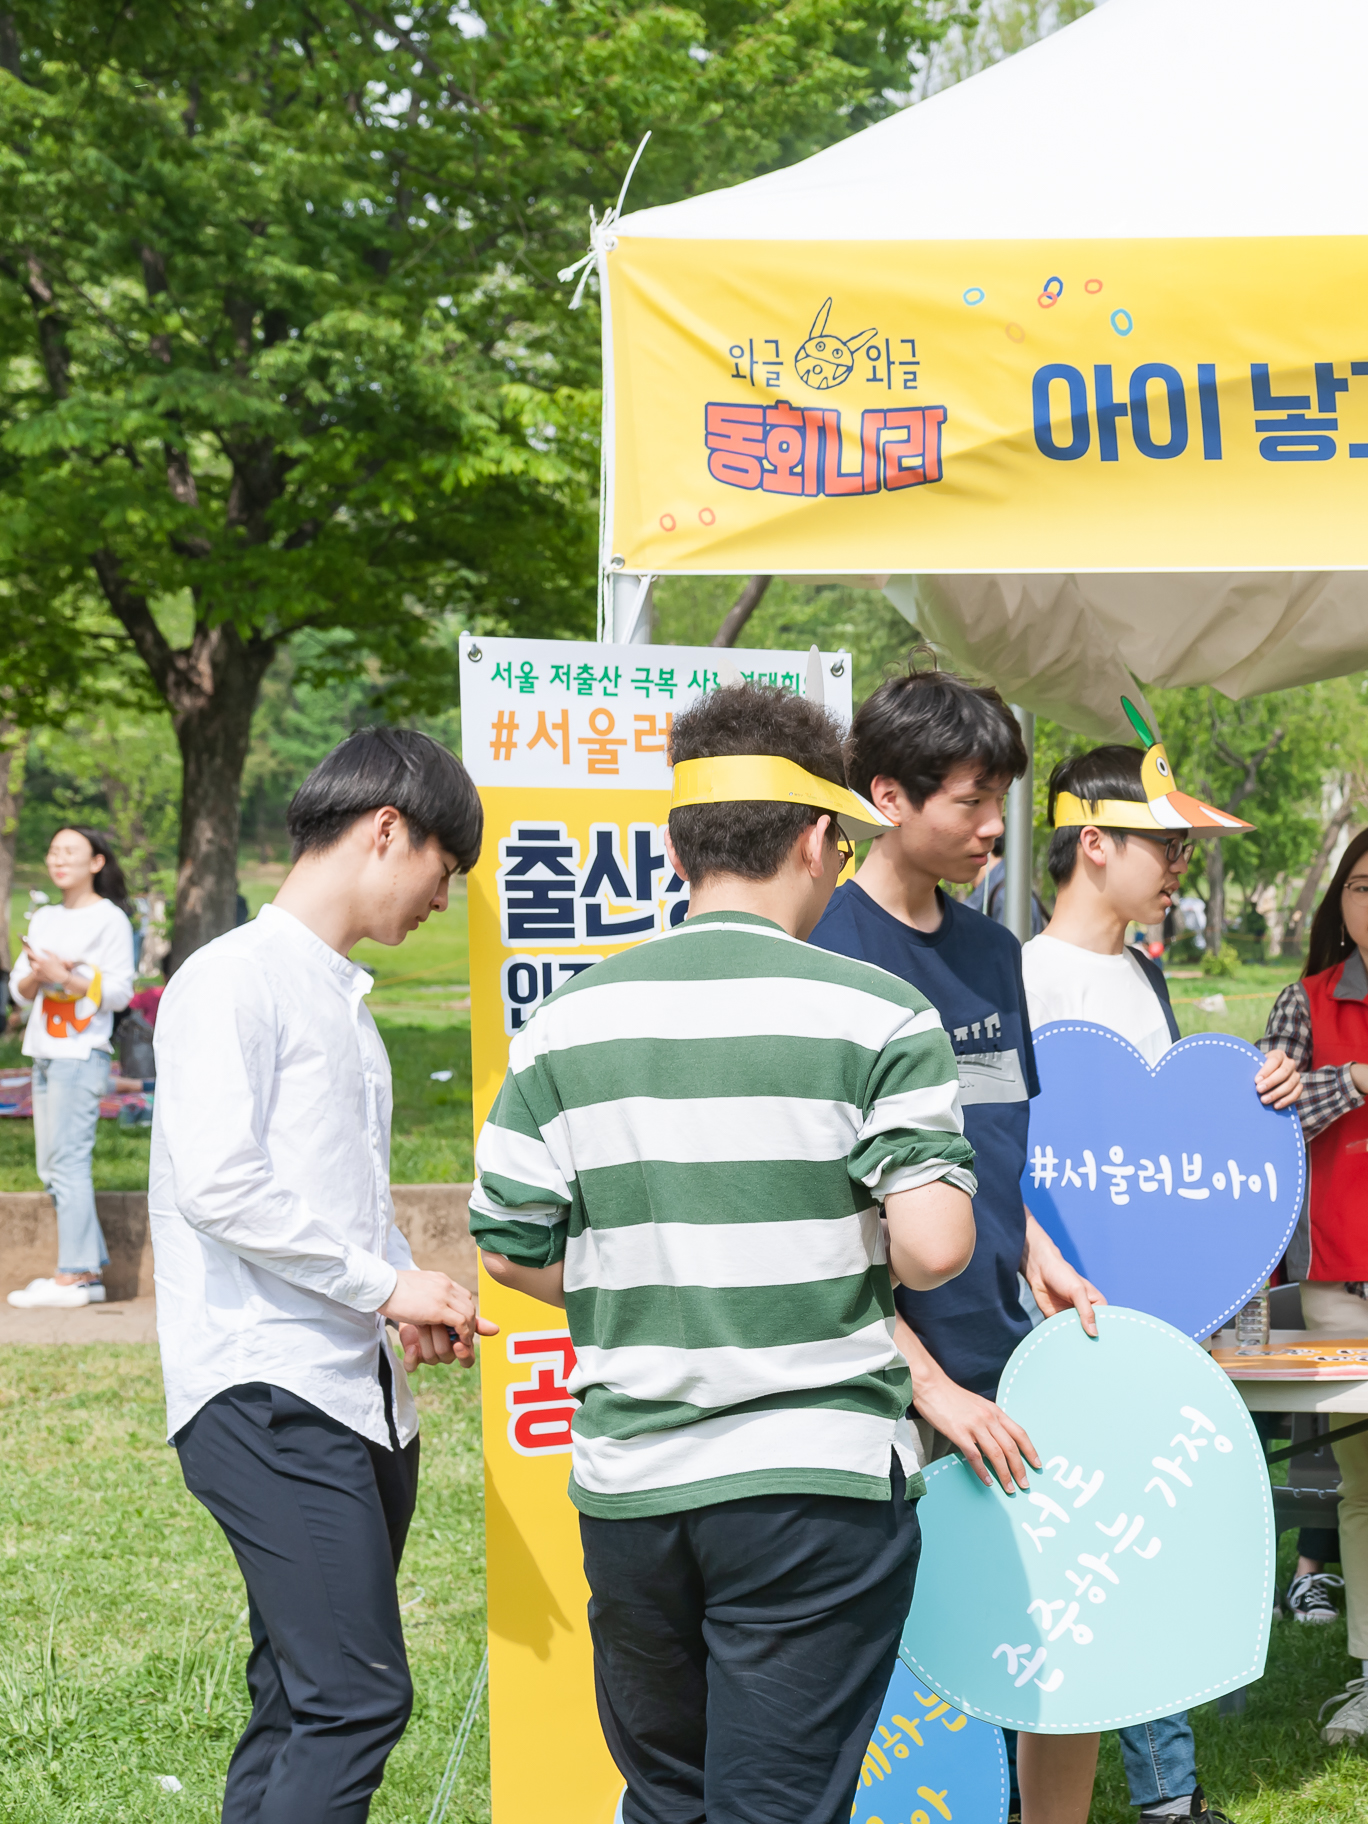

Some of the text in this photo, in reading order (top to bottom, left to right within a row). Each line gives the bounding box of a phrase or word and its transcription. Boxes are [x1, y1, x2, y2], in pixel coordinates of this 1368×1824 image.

[728, 338, 921, 390] 와글 와글
[1031, 362, 1223, 462] 아이
[704, 399, 948, 498] 동화나라
[490, 661, 539, 694] 서울
[549, 663, 622, 697] 저출산
[630, 667, 678, 699] 극복
[1029, 1144, 1278, 1206] #서울러브아이
[992, 1405, 1234, 1693] 존중하는 가정
[1020, 1455, 1105, 1553] 서로
